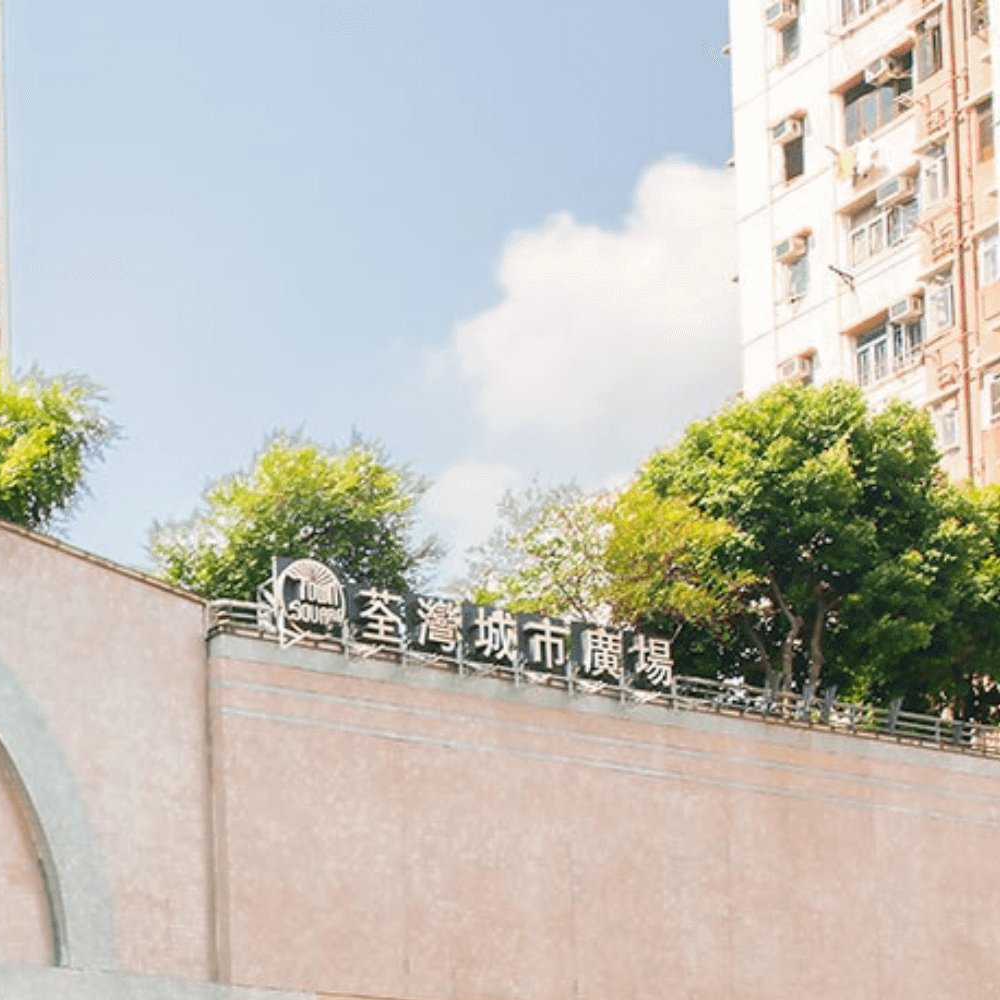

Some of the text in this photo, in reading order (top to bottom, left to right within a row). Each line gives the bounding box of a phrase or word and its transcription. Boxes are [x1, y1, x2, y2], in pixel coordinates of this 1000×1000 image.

[359, 587, 675, 687] 荃灣城市廣場
